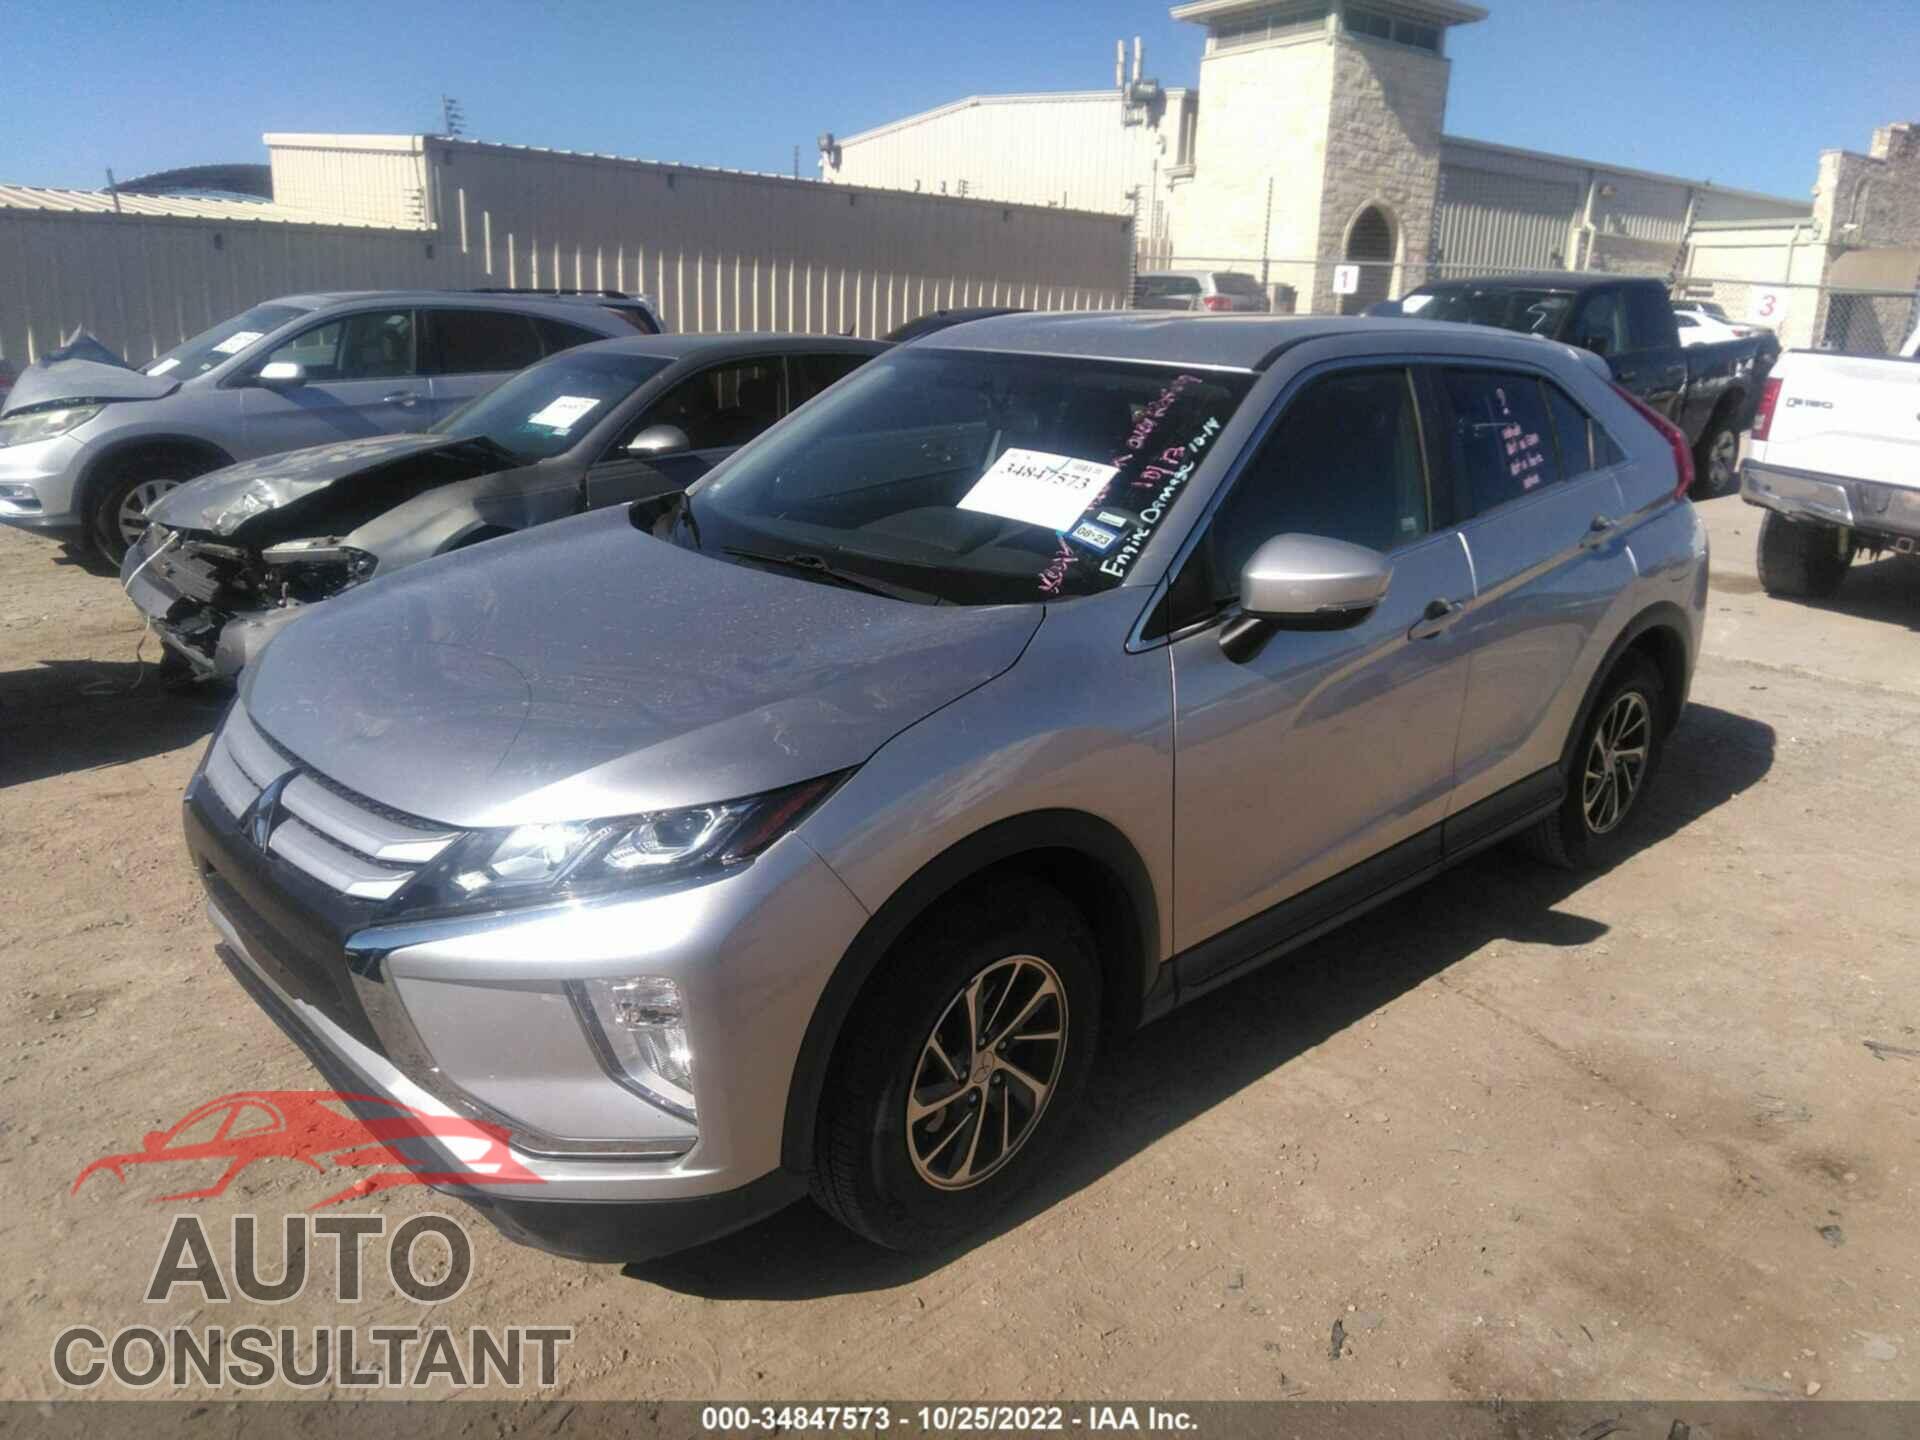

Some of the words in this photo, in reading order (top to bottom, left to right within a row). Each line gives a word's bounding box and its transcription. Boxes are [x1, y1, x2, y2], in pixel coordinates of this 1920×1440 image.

[1759, 294, 1776, 317] 3
[1000, 461, 1091, 490] 34847573
[1099, 527, 1150, 577] Engine
[1140, 460, 1195, 524] Damage
